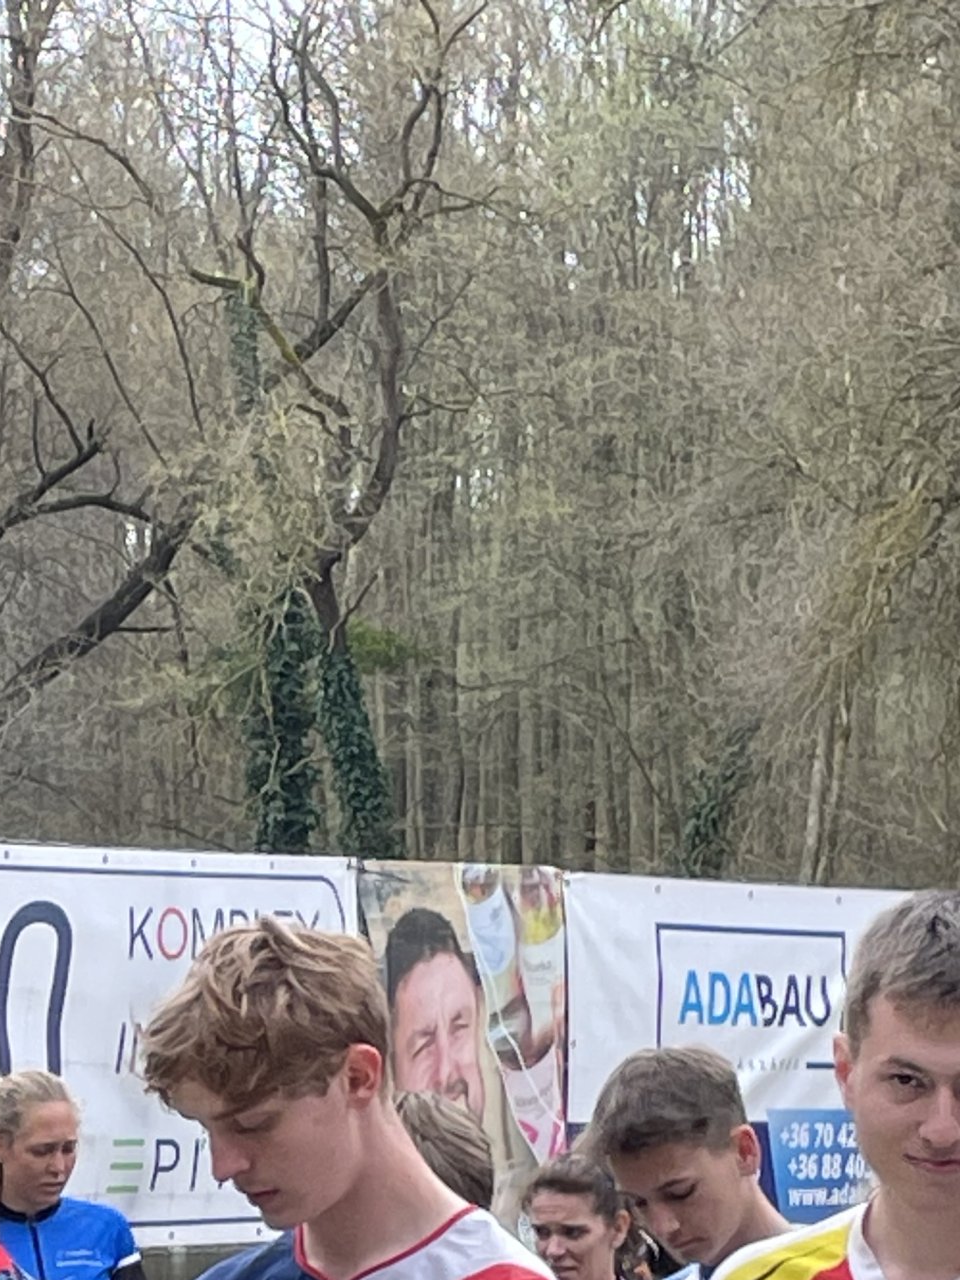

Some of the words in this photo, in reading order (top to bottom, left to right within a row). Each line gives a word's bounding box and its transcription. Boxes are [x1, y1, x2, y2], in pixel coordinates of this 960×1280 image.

[677, 969, 832, 1028] ADABAU
[780, 1122, 810, 1149] +36
[813, 1122, 834, 1148] 70
[837, 1122, 858, 1148] 42
[787, 1153, 818, 1180] +36
